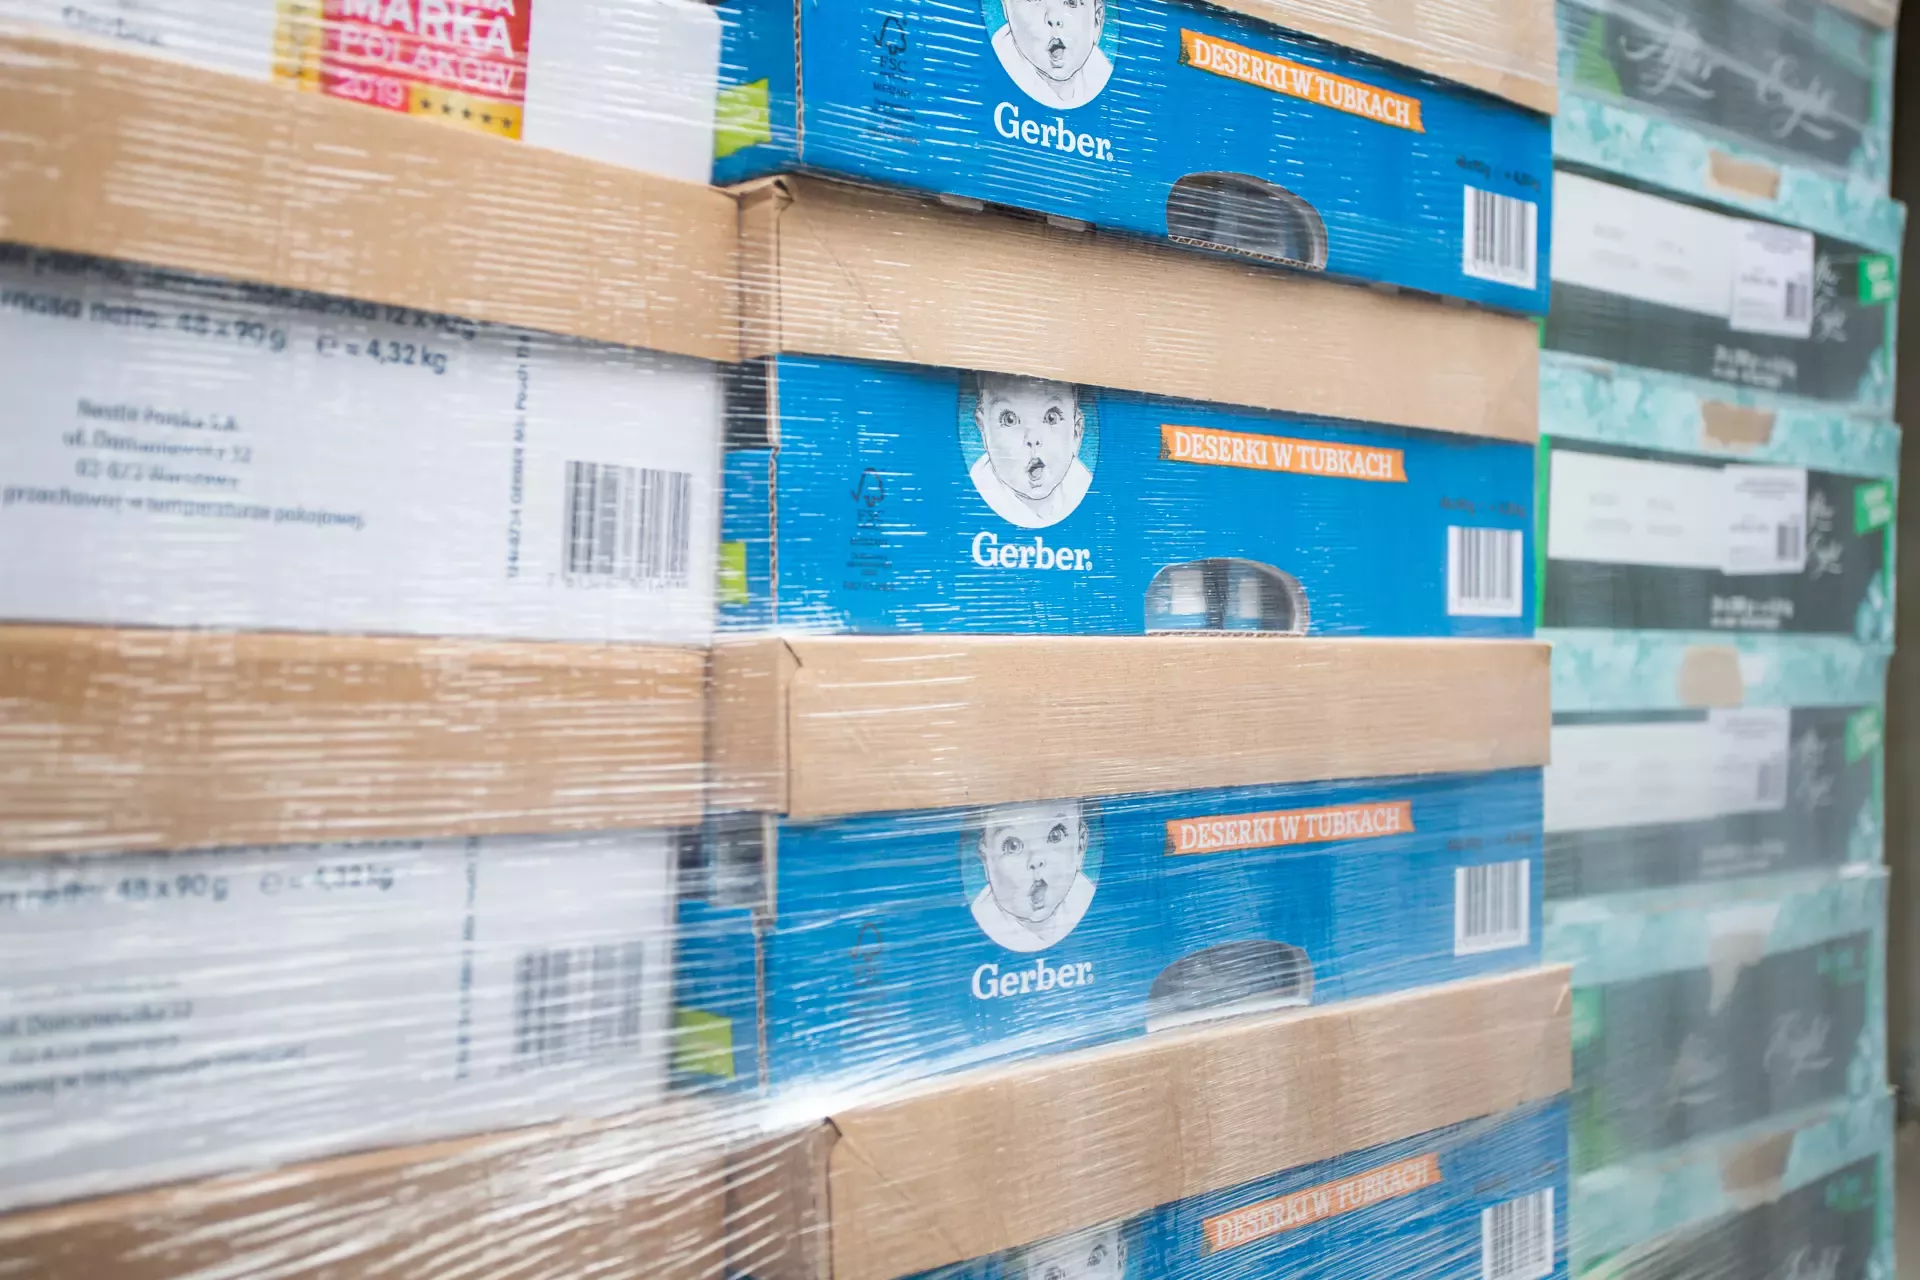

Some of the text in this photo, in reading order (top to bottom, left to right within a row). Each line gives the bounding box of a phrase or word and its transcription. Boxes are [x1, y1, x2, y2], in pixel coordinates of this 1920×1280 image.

[1193, 38, 1411, 127] DESERKI W TUBKACH
[1174, 431, 1393, 479] DESERKI W TUBKACH
[1181, 807, 1400, 850] DESERKI W TUBKACH
[1214, 1196, 1308, 1247] DESERKI
[1312, 1189, 1331, 1217] W
[1335, 1159, 1429, 1209] TUBKACH
